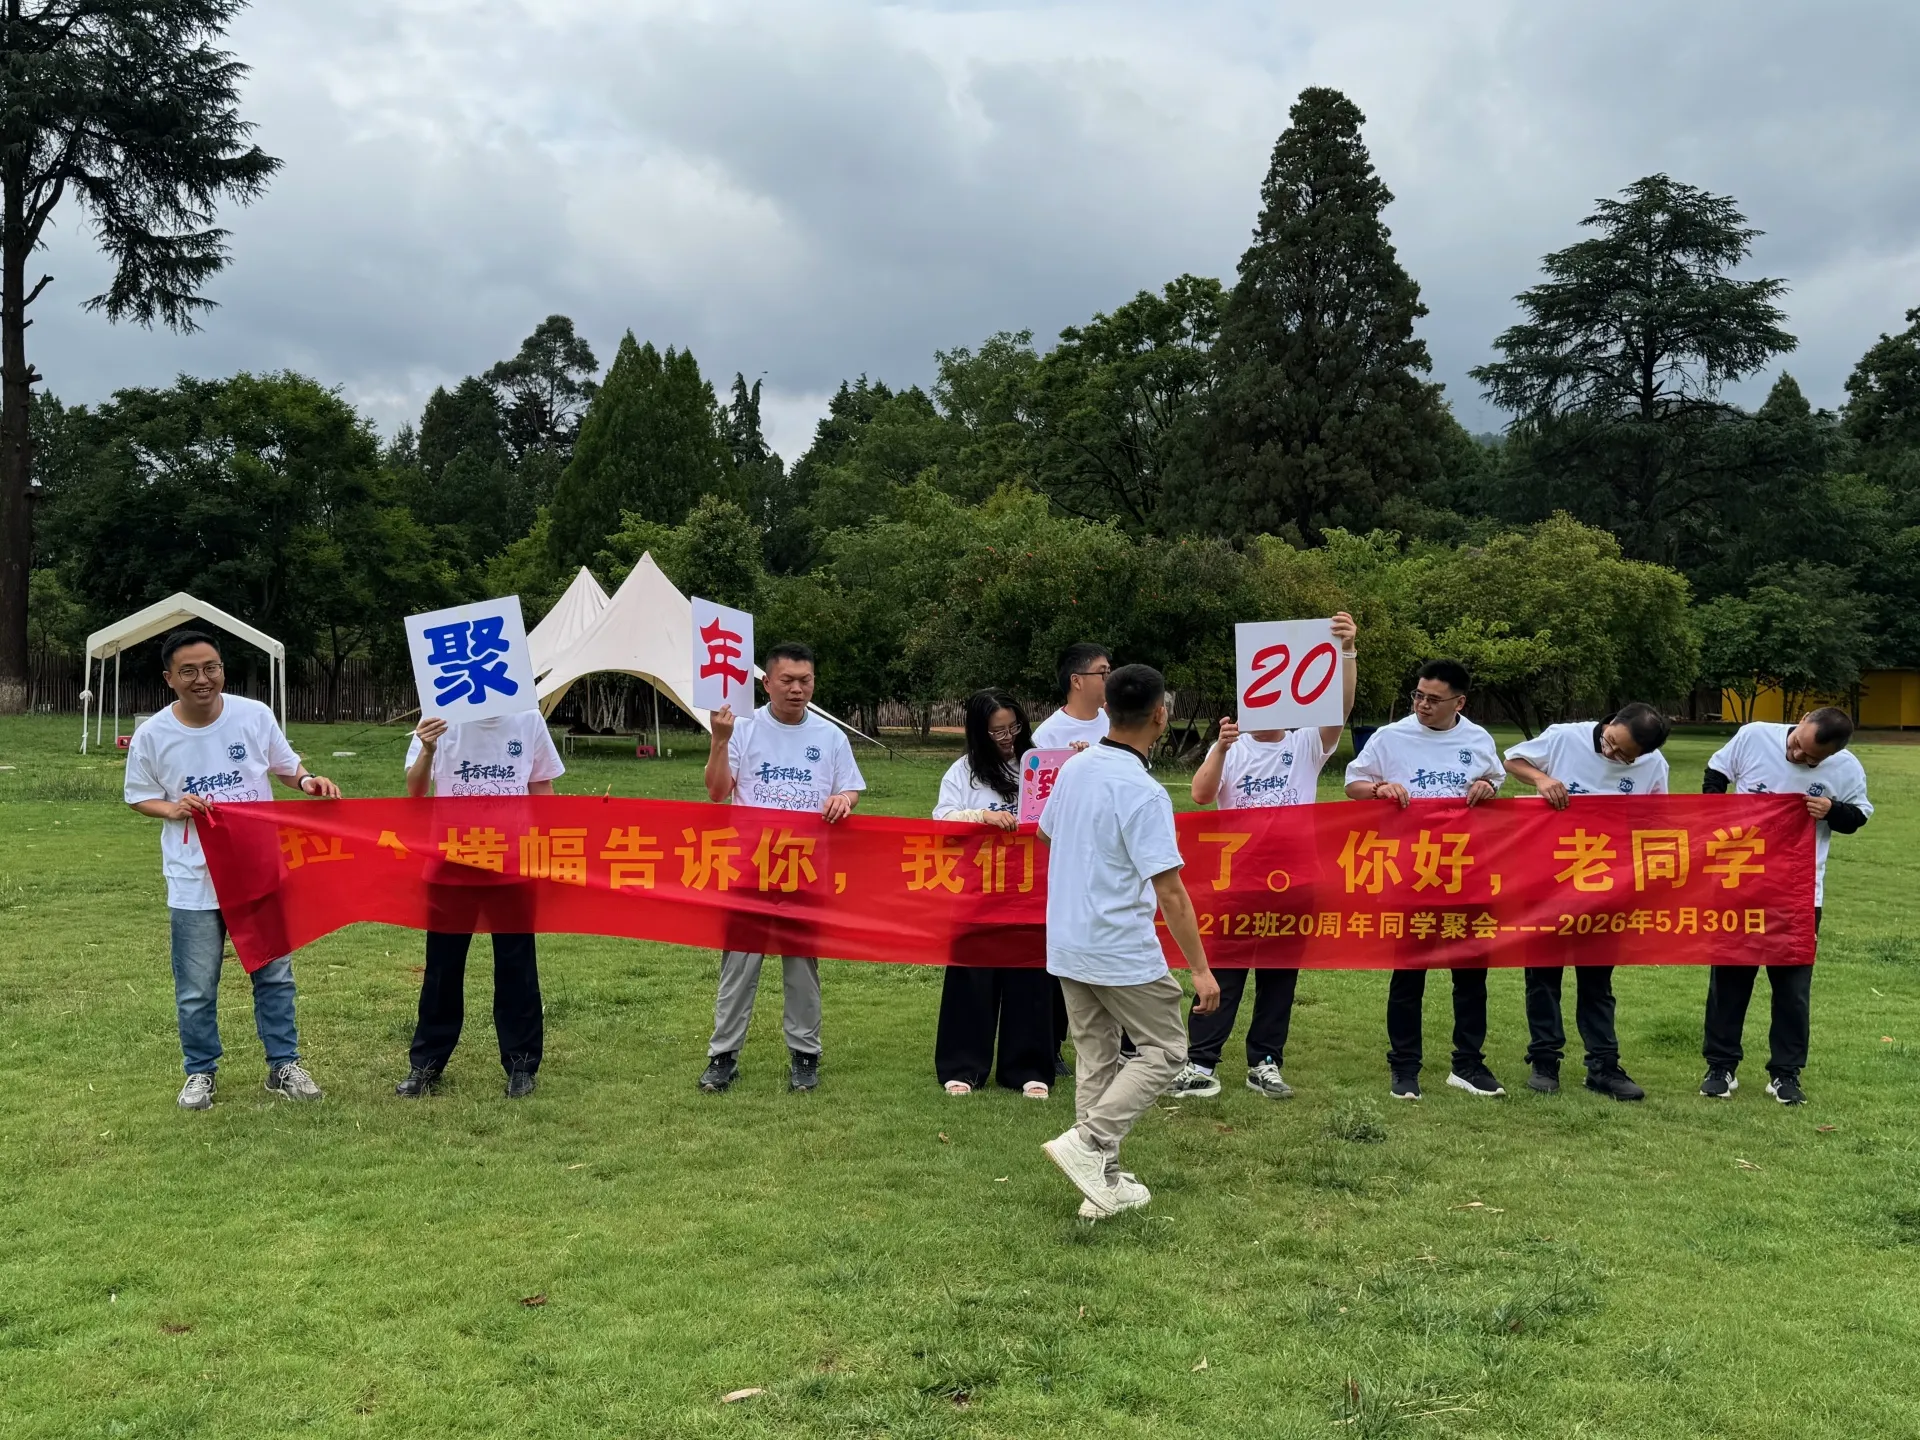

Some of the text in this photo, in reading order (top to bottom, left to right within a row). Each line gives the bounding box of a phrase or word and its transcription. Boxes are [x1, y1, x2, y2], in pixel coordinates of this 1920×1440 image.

[423, 616, 518, 707] 聚
[700, 617, 748, 699] 年
[1243, 642, 1337, 708] 20
